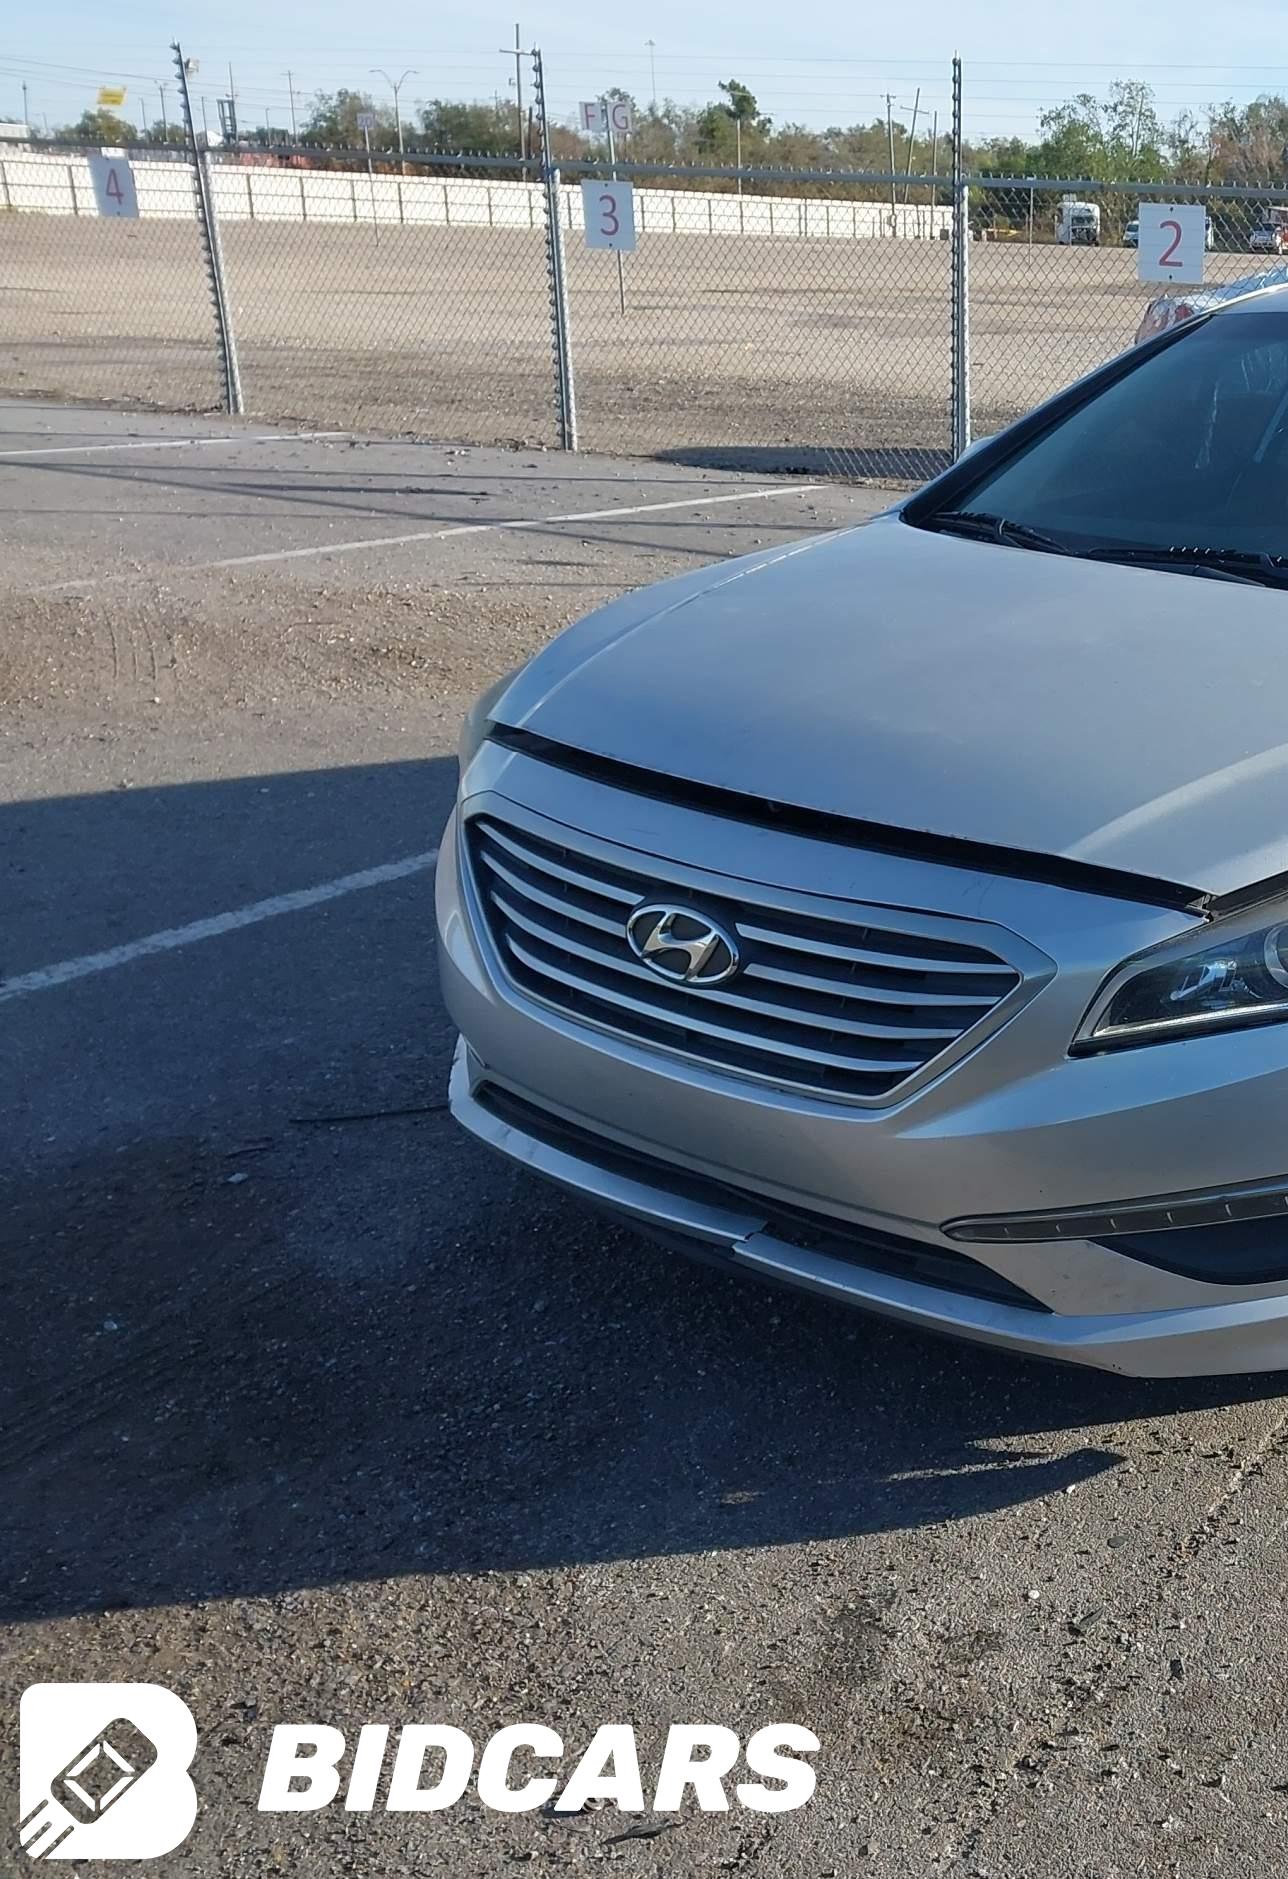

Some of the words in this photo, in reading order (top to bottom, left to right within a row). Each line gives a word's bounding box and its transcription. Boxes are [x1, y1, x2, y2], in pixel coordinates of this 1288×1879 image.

[612, 104, 628, 130] G
[105, 168, 124, 205] 4
[599, 195, 619, 236] 3
[1159, 221, 1183, 267] 2
